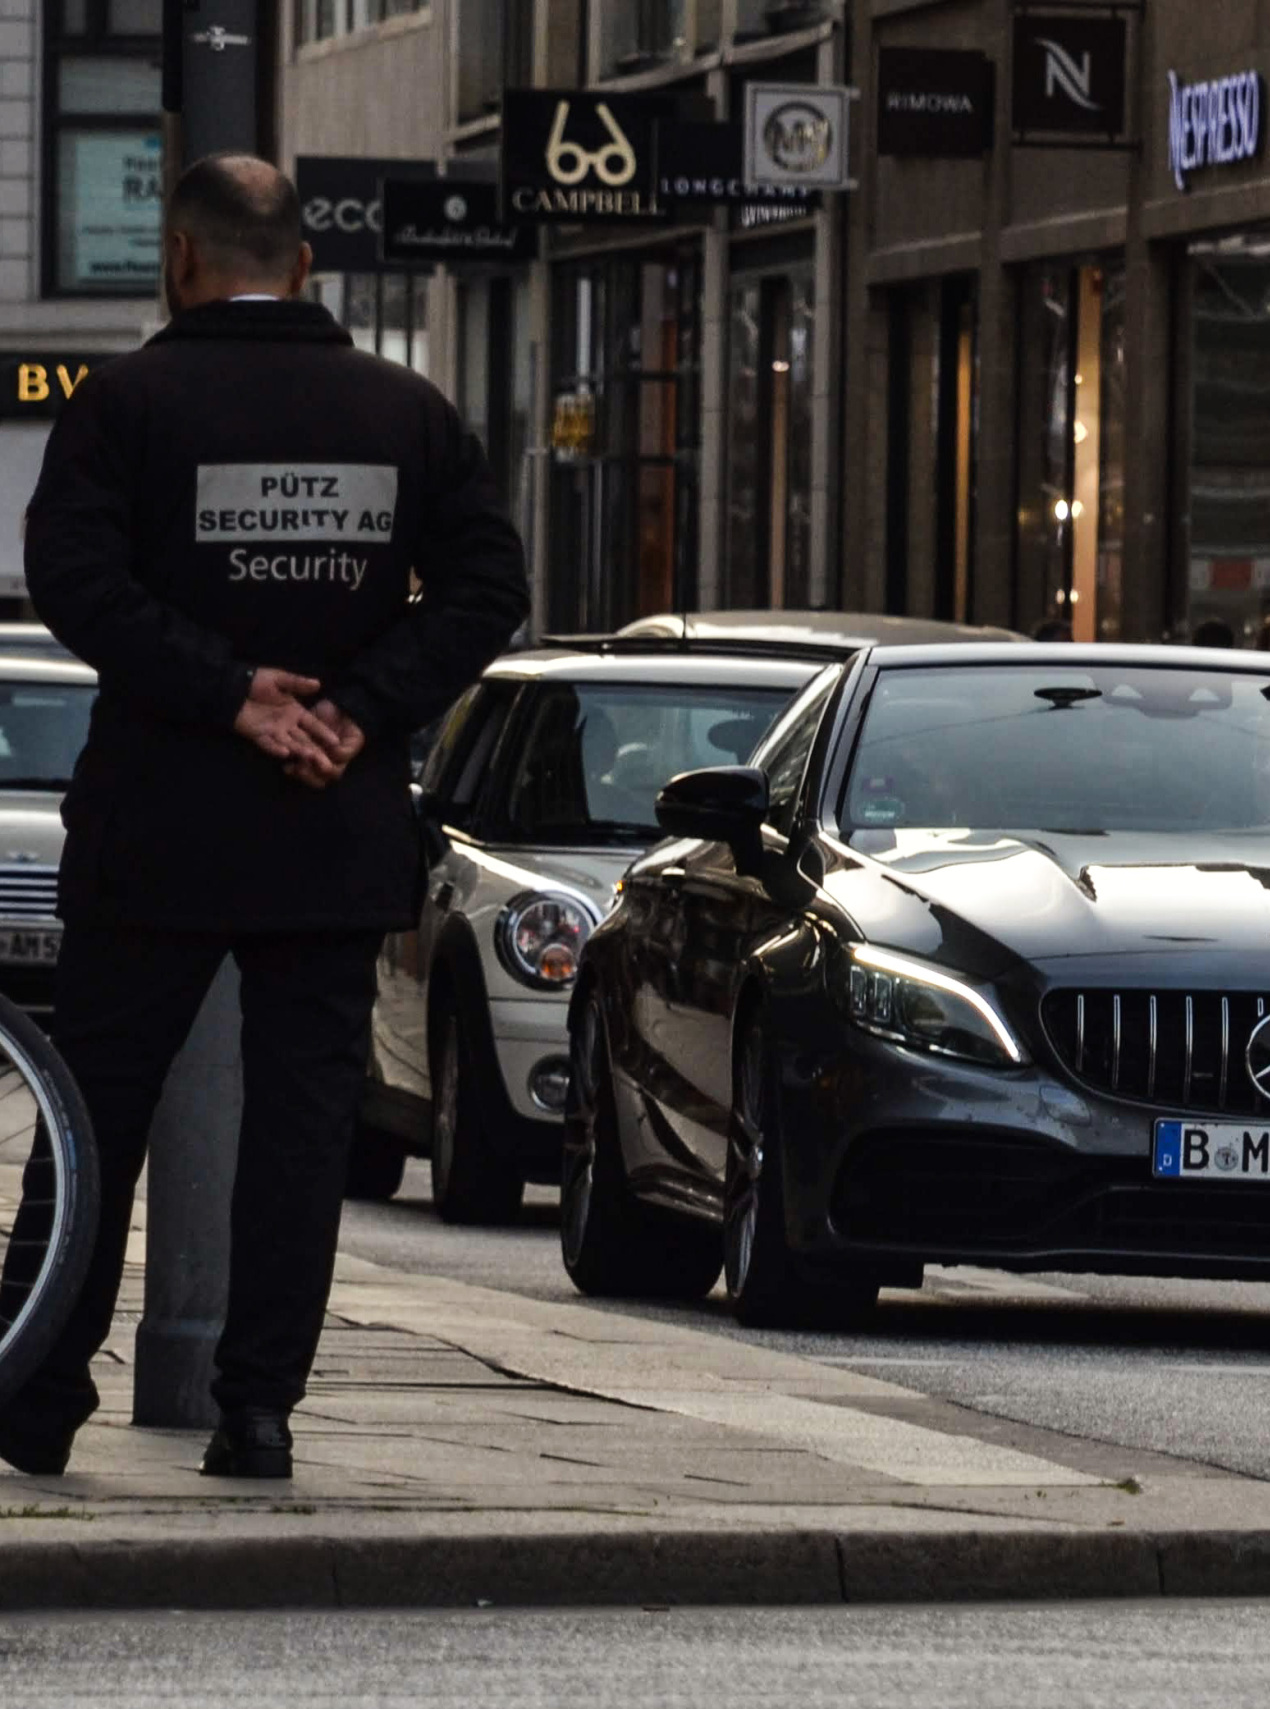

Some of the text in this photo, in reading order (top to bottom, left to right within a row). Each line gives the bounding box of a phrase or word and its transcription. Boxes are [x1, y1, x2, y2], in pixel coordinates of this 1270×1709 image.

[1167, 68, 1260, 191] NESPRESSO
[512, 187, 668, 217] CAMPBELL
[261, 473, 340, 498] PÜTZ
[199, 508, 392, 532] SECURITY AG
[229, 548, 368, 591] Security
[1182, 1128, 1210, 1171] B
